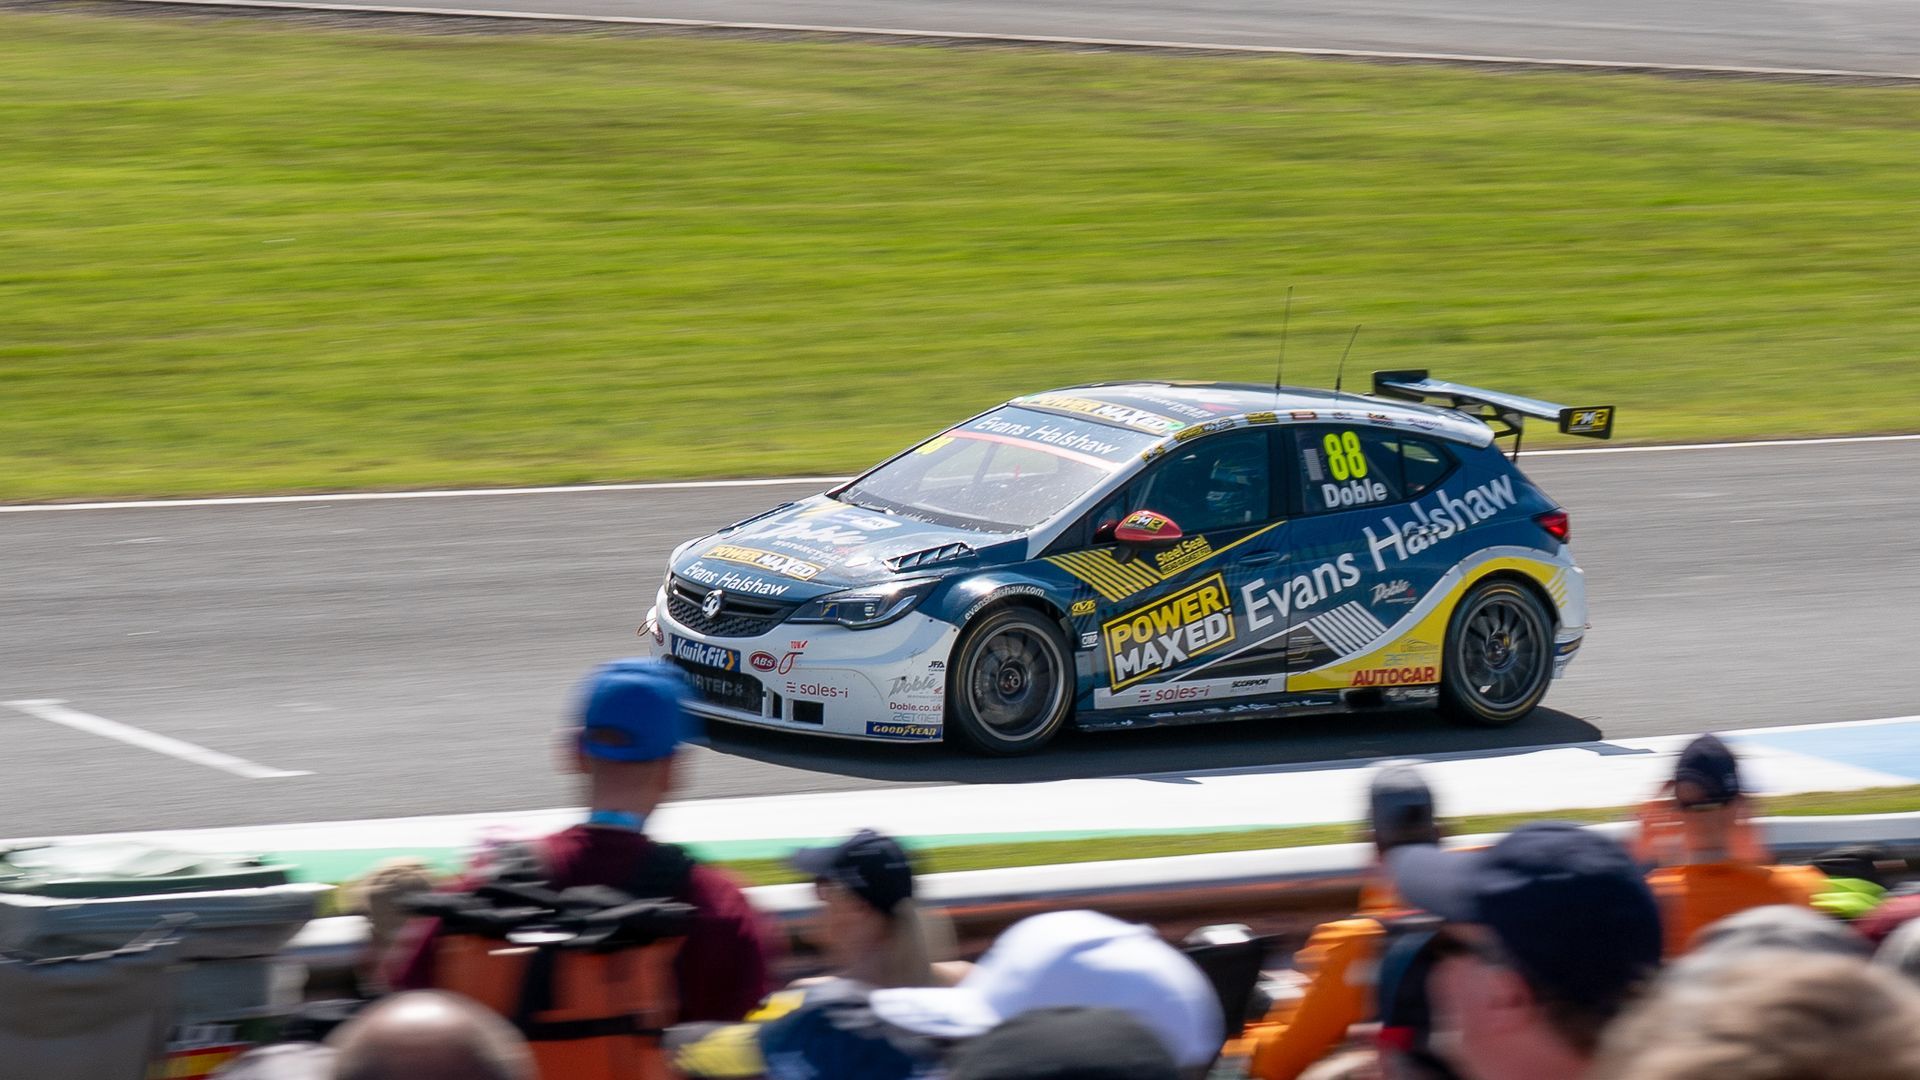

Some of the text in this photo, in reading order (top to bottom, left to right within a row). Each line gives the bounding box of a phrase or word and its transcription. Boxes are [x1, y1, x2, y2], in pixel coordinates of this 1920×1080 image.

[974, 417, 1120, 454] Evans Halshaw
[1323, 431, 1367, 480] 88
[1321, 478, 1388, 508] Doble
[709, 546, 761, 561] POWER
[756, 554, 816, 577] MAXED
[1155, 544, 1185, 566] Steel
[1241, 474, 1517, 632] Evans Halshaw
[683, 561, 790, 596] Evans Halshaw
[964, 585, 1045, 620] evanshalshaw.com
[1110, 585, 1223, 655] POWER
[675, 638, 727, 669] KwikFit
[753, 656, 773, 667] ABS
[1115, 612, 1227, 681] MAXED
[800, 683, 848, 698] sales-i
[1231, 678, 1271, 689] SCORPION
[1352, 667, 1435, 686] AUTOCAR
[890, 702, 942, 711] Doble.co.uk
[1155, 685, 1209, 701] sales-i
[873, 725, 937, 736] GOODYEAR
